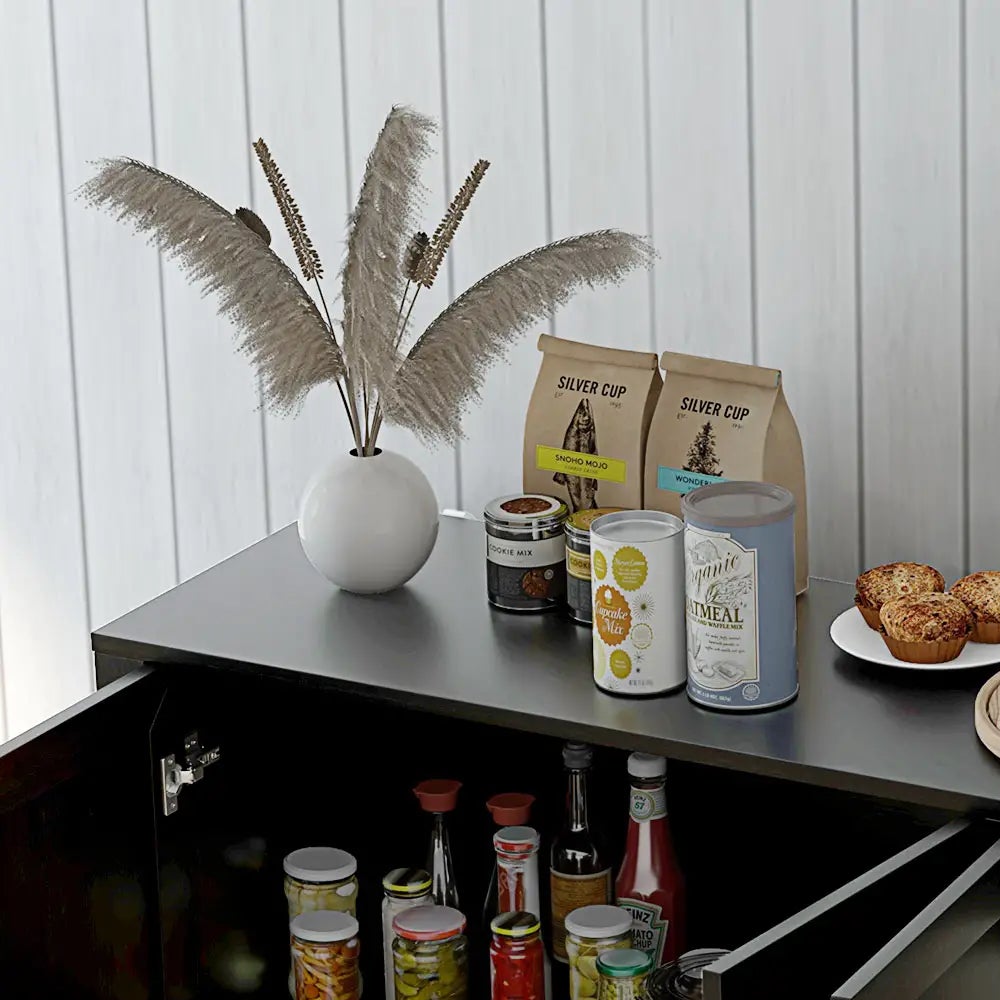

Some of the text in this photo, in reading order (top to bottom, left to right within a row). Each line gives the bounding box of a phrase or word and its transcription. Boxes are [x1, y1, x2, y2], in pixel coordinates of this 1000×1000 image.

[558, 376, 598, 394] SILVER
[602, 383, 626, 398] CUP
[680, 396, 750, 420] SILVER CUP
[556, 454, 584, 465] SNOHO
[586, 460, 608, 470] MOJO
[595, 600, 628, 620] Cupcake
[604, 618, 624, 635] Mix
[634, 802, 644, 810] 57
